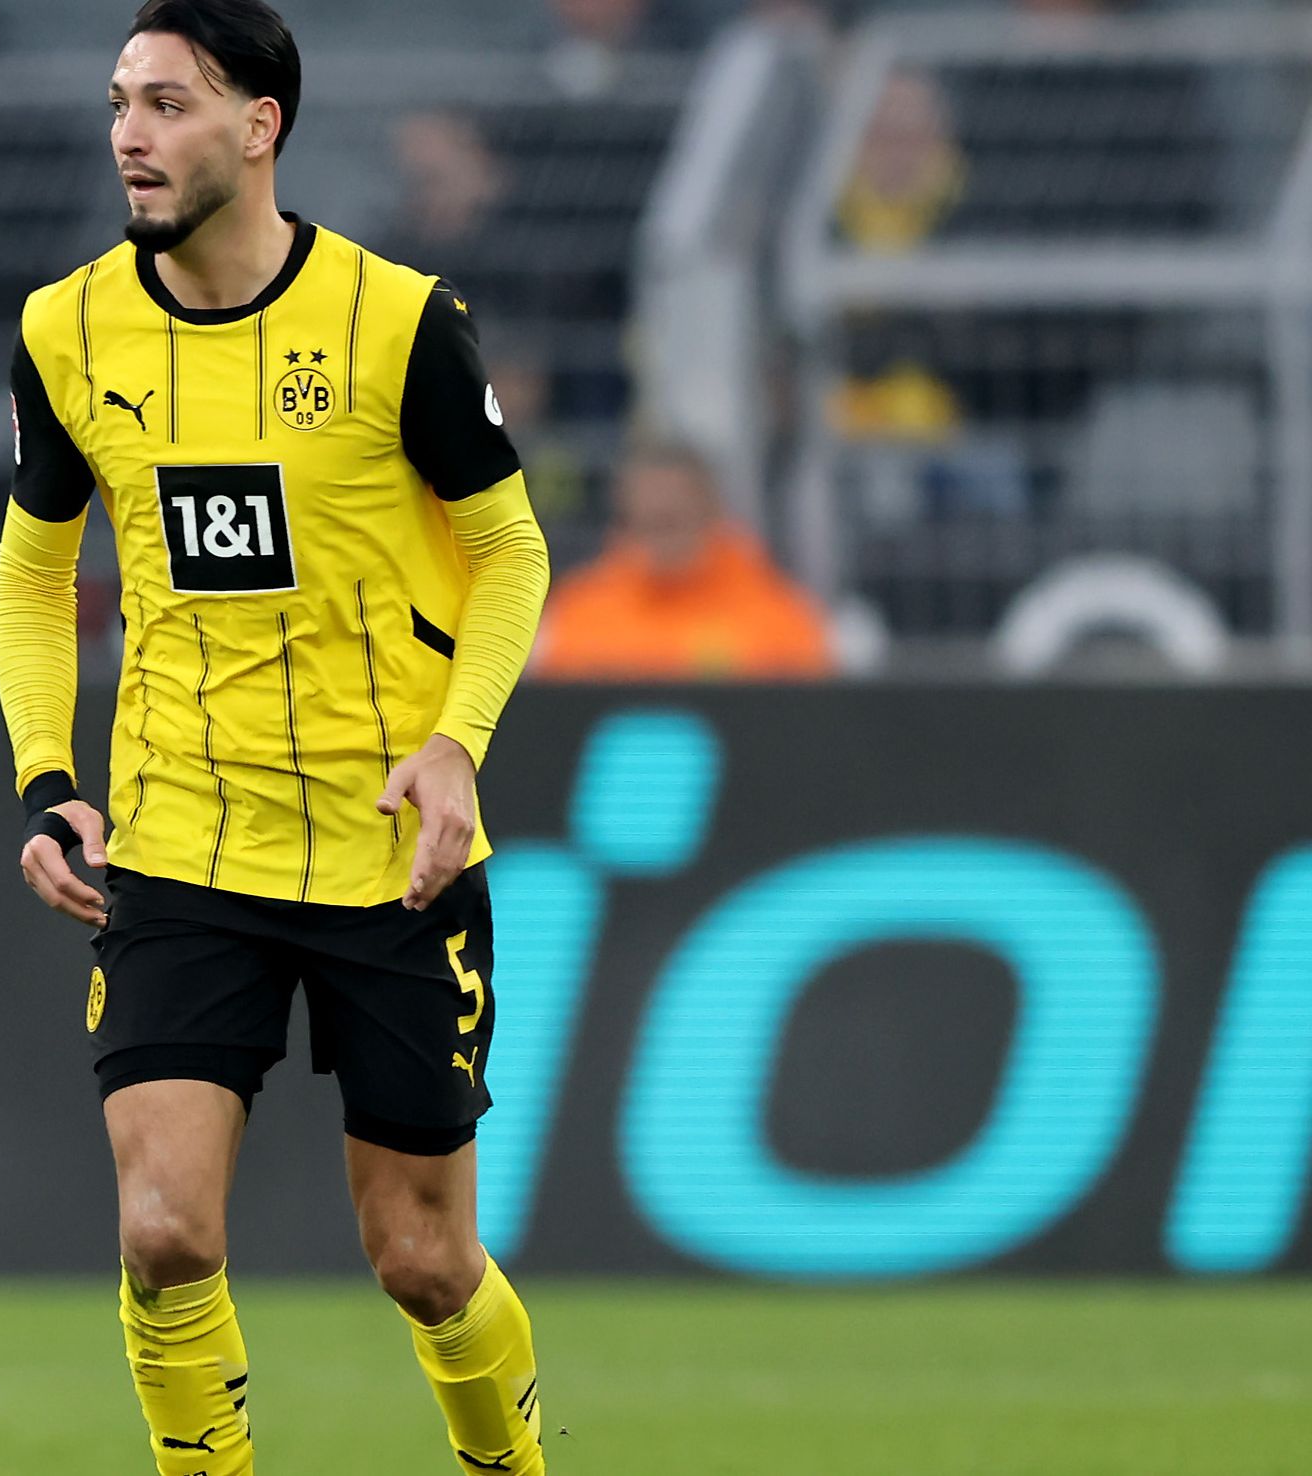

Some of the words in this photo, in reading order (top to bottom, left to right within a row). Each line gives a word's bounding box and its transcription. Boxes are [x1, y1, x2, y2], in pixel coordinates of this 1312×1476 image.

[282, 375, 329, 412] BVB
[296, 412, 313, 425] 09
[171, 495, 275, 558] 1&1
[445, 930, 484, 1034] 5
